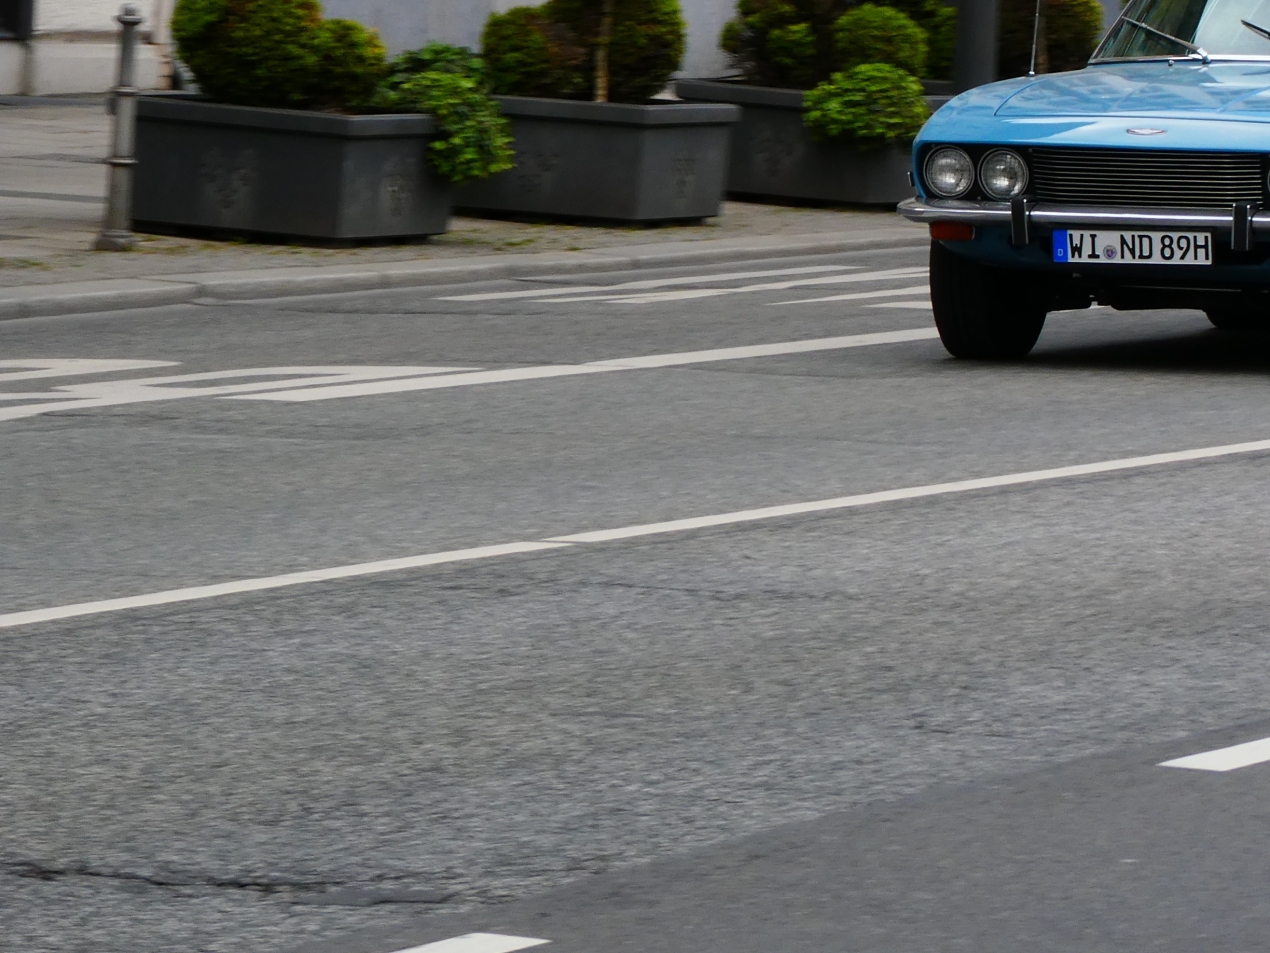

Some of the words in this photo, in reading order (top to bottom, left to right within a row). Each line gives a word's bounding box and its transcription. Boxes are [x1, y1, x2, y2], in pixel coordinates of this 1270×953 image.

[1057, 248, 1064, 257] D
[1069, 233, 1101, 259] WI
[1119, 234, 1153, 260] ND
[1160, 235, 1210, 261] 89H
